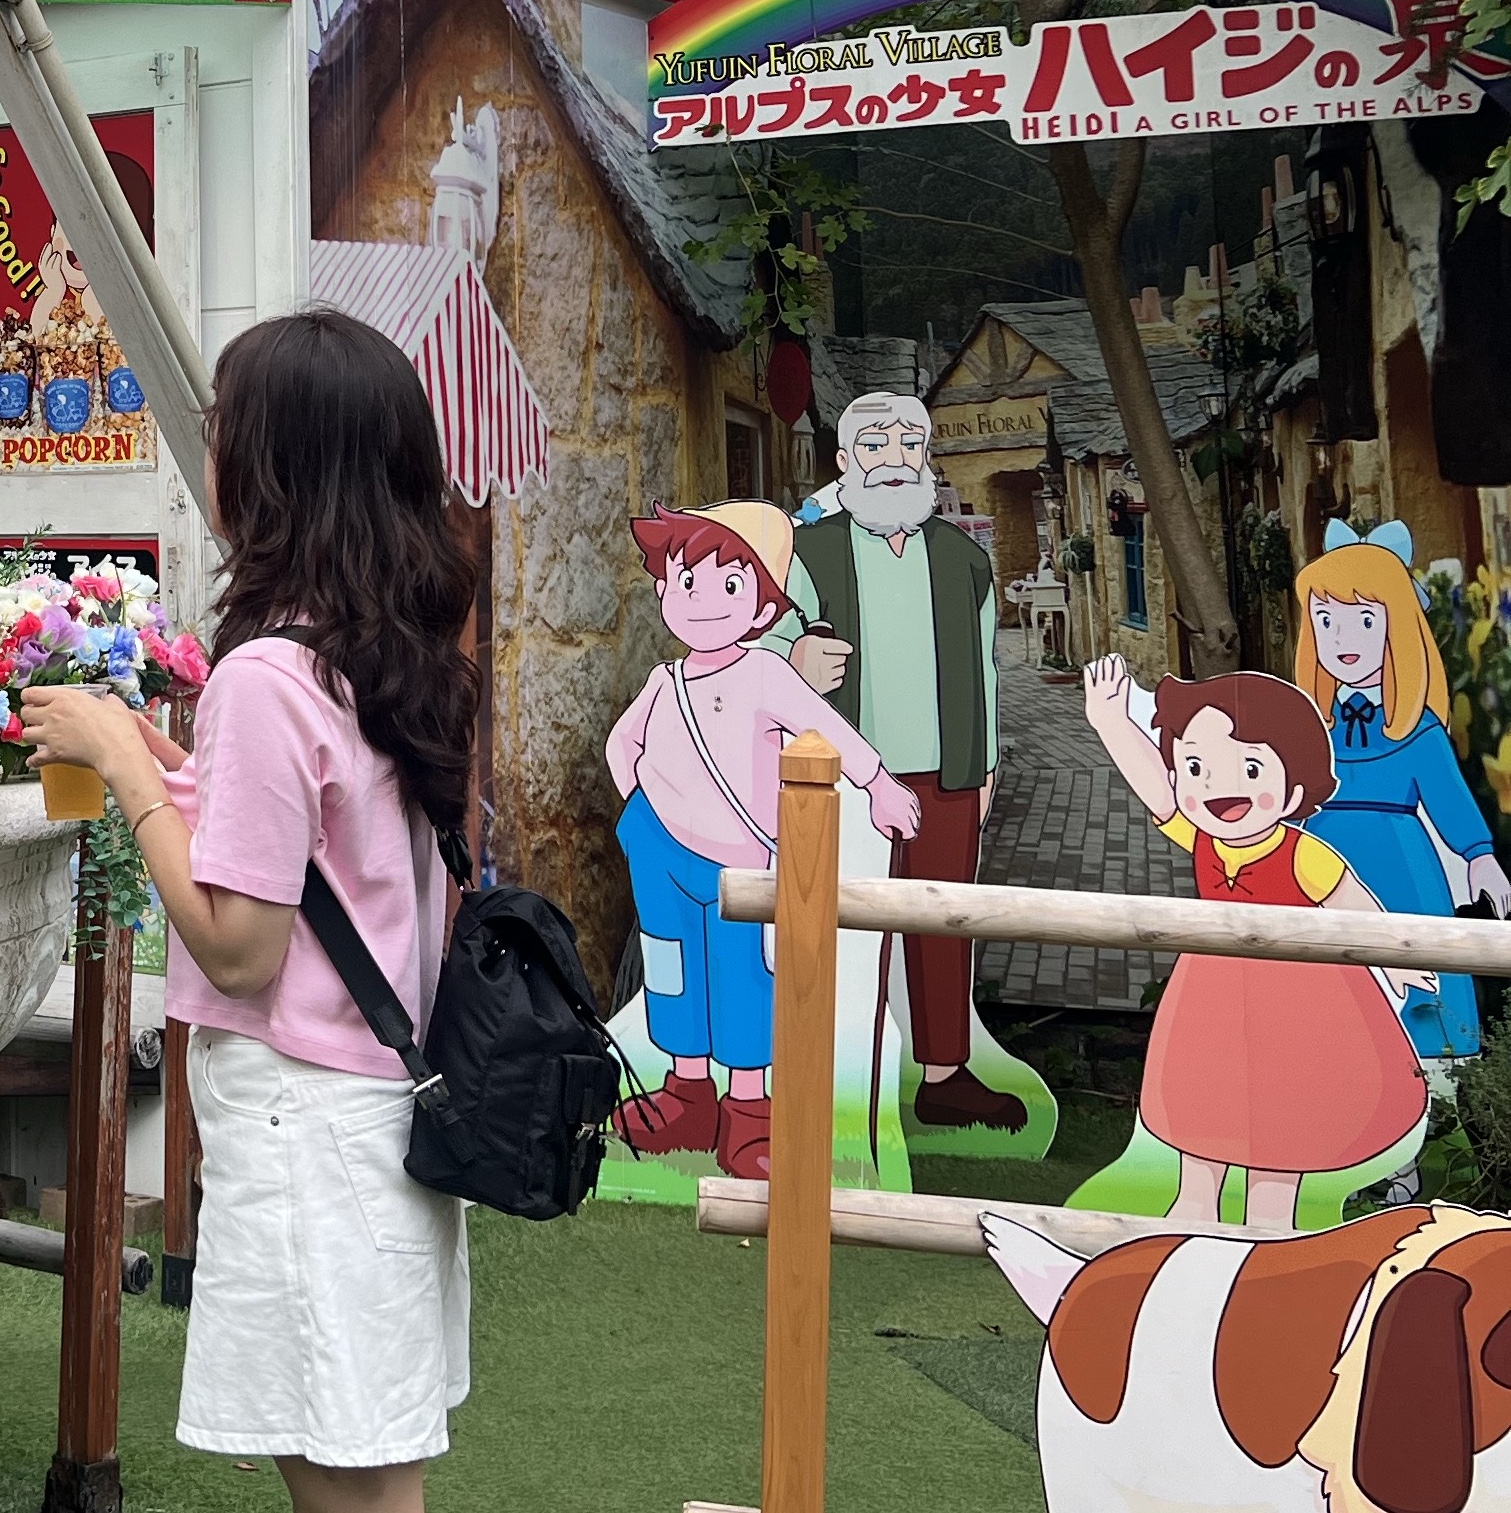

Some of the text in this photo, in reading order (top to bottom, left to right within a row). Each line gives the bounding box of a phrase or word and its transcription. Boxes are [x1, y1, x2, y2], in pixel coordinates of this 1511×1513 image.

[655, 29, 1003, 86] YUFUIN FLORAL VILLAGE
[657, 69, 1007, 141] アルプスの少女
[1022, 92, 1474, 141] HEIDI A GIRL OF THE ALPS
[976, 412, 1036, 435] FLORAL
[1, 432, 134, 465] POPCORN
